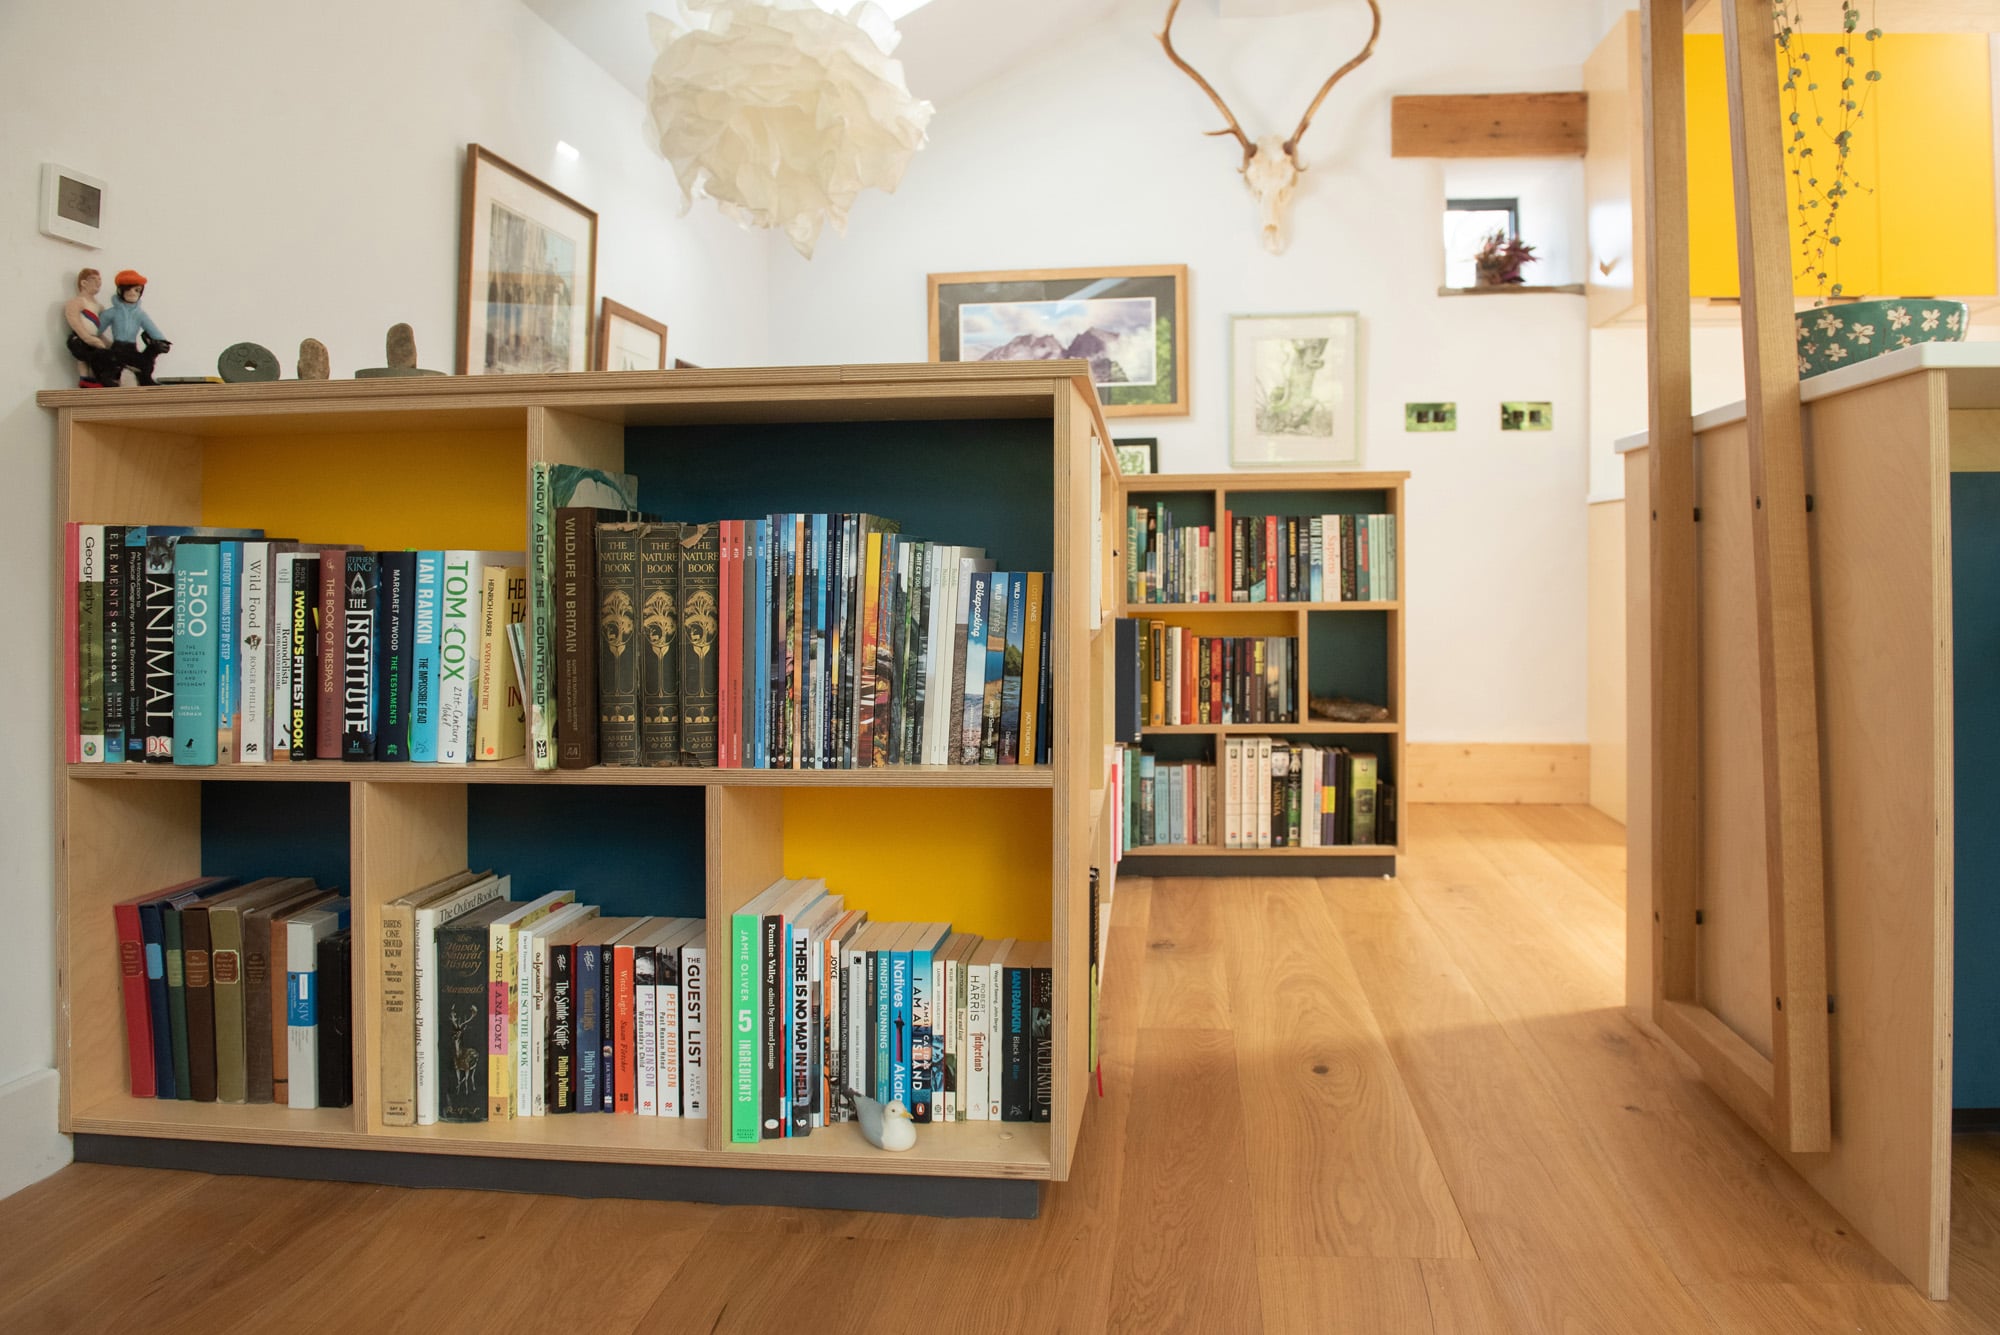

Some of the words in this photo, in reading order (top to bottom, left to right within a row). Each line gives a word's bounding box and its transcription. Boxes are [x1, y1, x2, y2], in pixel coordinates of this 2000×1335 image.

[536, 471, 545, 515] KNOW
[1311, 518, 1321, 535] IAIN
[536, 523, 544, 573] ABOUT
[565, 518, 576, 577] WILDLIFE
[600, 552, 635, 561] NATURE
[642, 553, 677, 561] NATURE
[683, 552, 719, 560] NATURE
[1311, 537, 1322, 565] BANKS
[83, 537, 95, 614] Geography
[110, 533, 118, 617] ELEMENTS
[222, 552, 231, 585] BAREFOOT
[249, 560, 262, 591] Wild
[347, 563, 372, 572] KING
[419, 559, 434, 583] IAN
[605, 564, 630, 572] BOOK
[648, 565, 673, 573] BOOK
[688, 564, 714, 572] BOOK
[176, 570, 186, 635] STRETCHES
[222, 587, 231, 615] RUNNING
[326, 578, 335, 597] THE
[392, 569, 400, 614] MARGARET
[445, 561, 468, 618] TOM
[536, 580, 544, 608] THE
[565, 583, 576, 597] IN
[188, 570, 207, 637] 1,500
[248, 597, 260, 628] Food
[325, 599, 334, 628] BOOK
[349, 599, 366, 608] THE
[417, 589, 433, 645] RANKIN
[971, 580, 984, 637] Bikepacking
[992, 600, 1001, 632] running
[1011, 600, 1019, 633] swimming
[111, 622, 117, 633] OF
[222, 617, 231, 632] STEP
[222, 634, 230, 642] BY
[293, 596, 304, 655] WORLD'S
[325, 632, 334, 645] OF
[391, 616, 400, 651] ATWOOD
[485, 611, 493, 636] HARRER
[565, 601, 576, 652] BRITAIN
[146, 579, 173, 726] ANIMAL
[222, 644, 230, 659] STEP
[281, 629, 290, 685] Remodelista
[419, 658, 428, 669] THE
[443, 628, 465, 681] COX
[293, 656, 303, 708] FITTEST
[324, 647, 334, 692] TRESPASS
[344, 609, 373, 735] INSTITUTE
[389, 673, 397, 725] TESTAMENTS
[418, 671, 428, 706] IMPOSSIBLE
[293, 710, 303, 748] BOOK
[417, 708, 427, 724] DEAD
[147, 737, 170, 753] DK
[384, 920, 402, 928] BIRDS
[440, 909, 453, 921] The
[454, 898, 475, 914] Oxford
[741, 930, 749, 961] JAMIE
[768, 924, 776, 956] Pennine
[495, 936, 503, 986] NATURE
[767, 959, 776, 984] Valley
[795, 938, 807, 982] THERE
[415, 969, 424, 1015] Flowerless
[555, 981, 569, 995] The
[688, 965, 700, 1022] GUEST
[795, 985, 807, 997] IS
[880, 958, 888, 1001] MINDFUL
[894, 960, 905, 1008] Natives
[1012, 971, 1021, 989] IAN
[297, 1002, 309, 1021] KJV
[554, 997, 569, 1020] Subtle
[619, 995, 627, 1015] Light
[645, 993, 654, 1027] PETER
[667, 993, 675, 1027] PETER
[795, 1000, 807, 1020] NO
[913, 987, 922, 1008] AM
[970, 976, 979, 1021] HARRIS
[1012, 990, 1021, 1033] RANKIN
[415, 1017, 424, 1046] Plants
[494, 991, 502, 1050] ANATOMY
[520, 1000, 528, 1037] SCYTHE
[739, 1010, 751, 1032] 5
[880, 1004, 888, 1048] RUNNING
[913, 1014, 922, 1033] AN
[552, 1021, 569, 1050] Knife
[688, 1031, 700, 1067] LIST
[795, 1022, 807, 1050] MAP
[555, 1056, 568, 1076] Philip
[581, 1051, 595, 1073] Philip
[645, 1032, 654, 1087] ROBINSON
[667, 1033, 676, 1087] ROBINSON
[739, 1040, 751, 1102] INGREDIENTS
[767, 1042, 775, 1069] Jennings
[795, 1052, 807, 1066] IN
[913, 1040, 922, 1090] ISLAND
[558, 1078, 568, 1107] Pullman
[584, 1074, 595, 1106] Pullman
[795, 1069, 807, 1103] HELL
